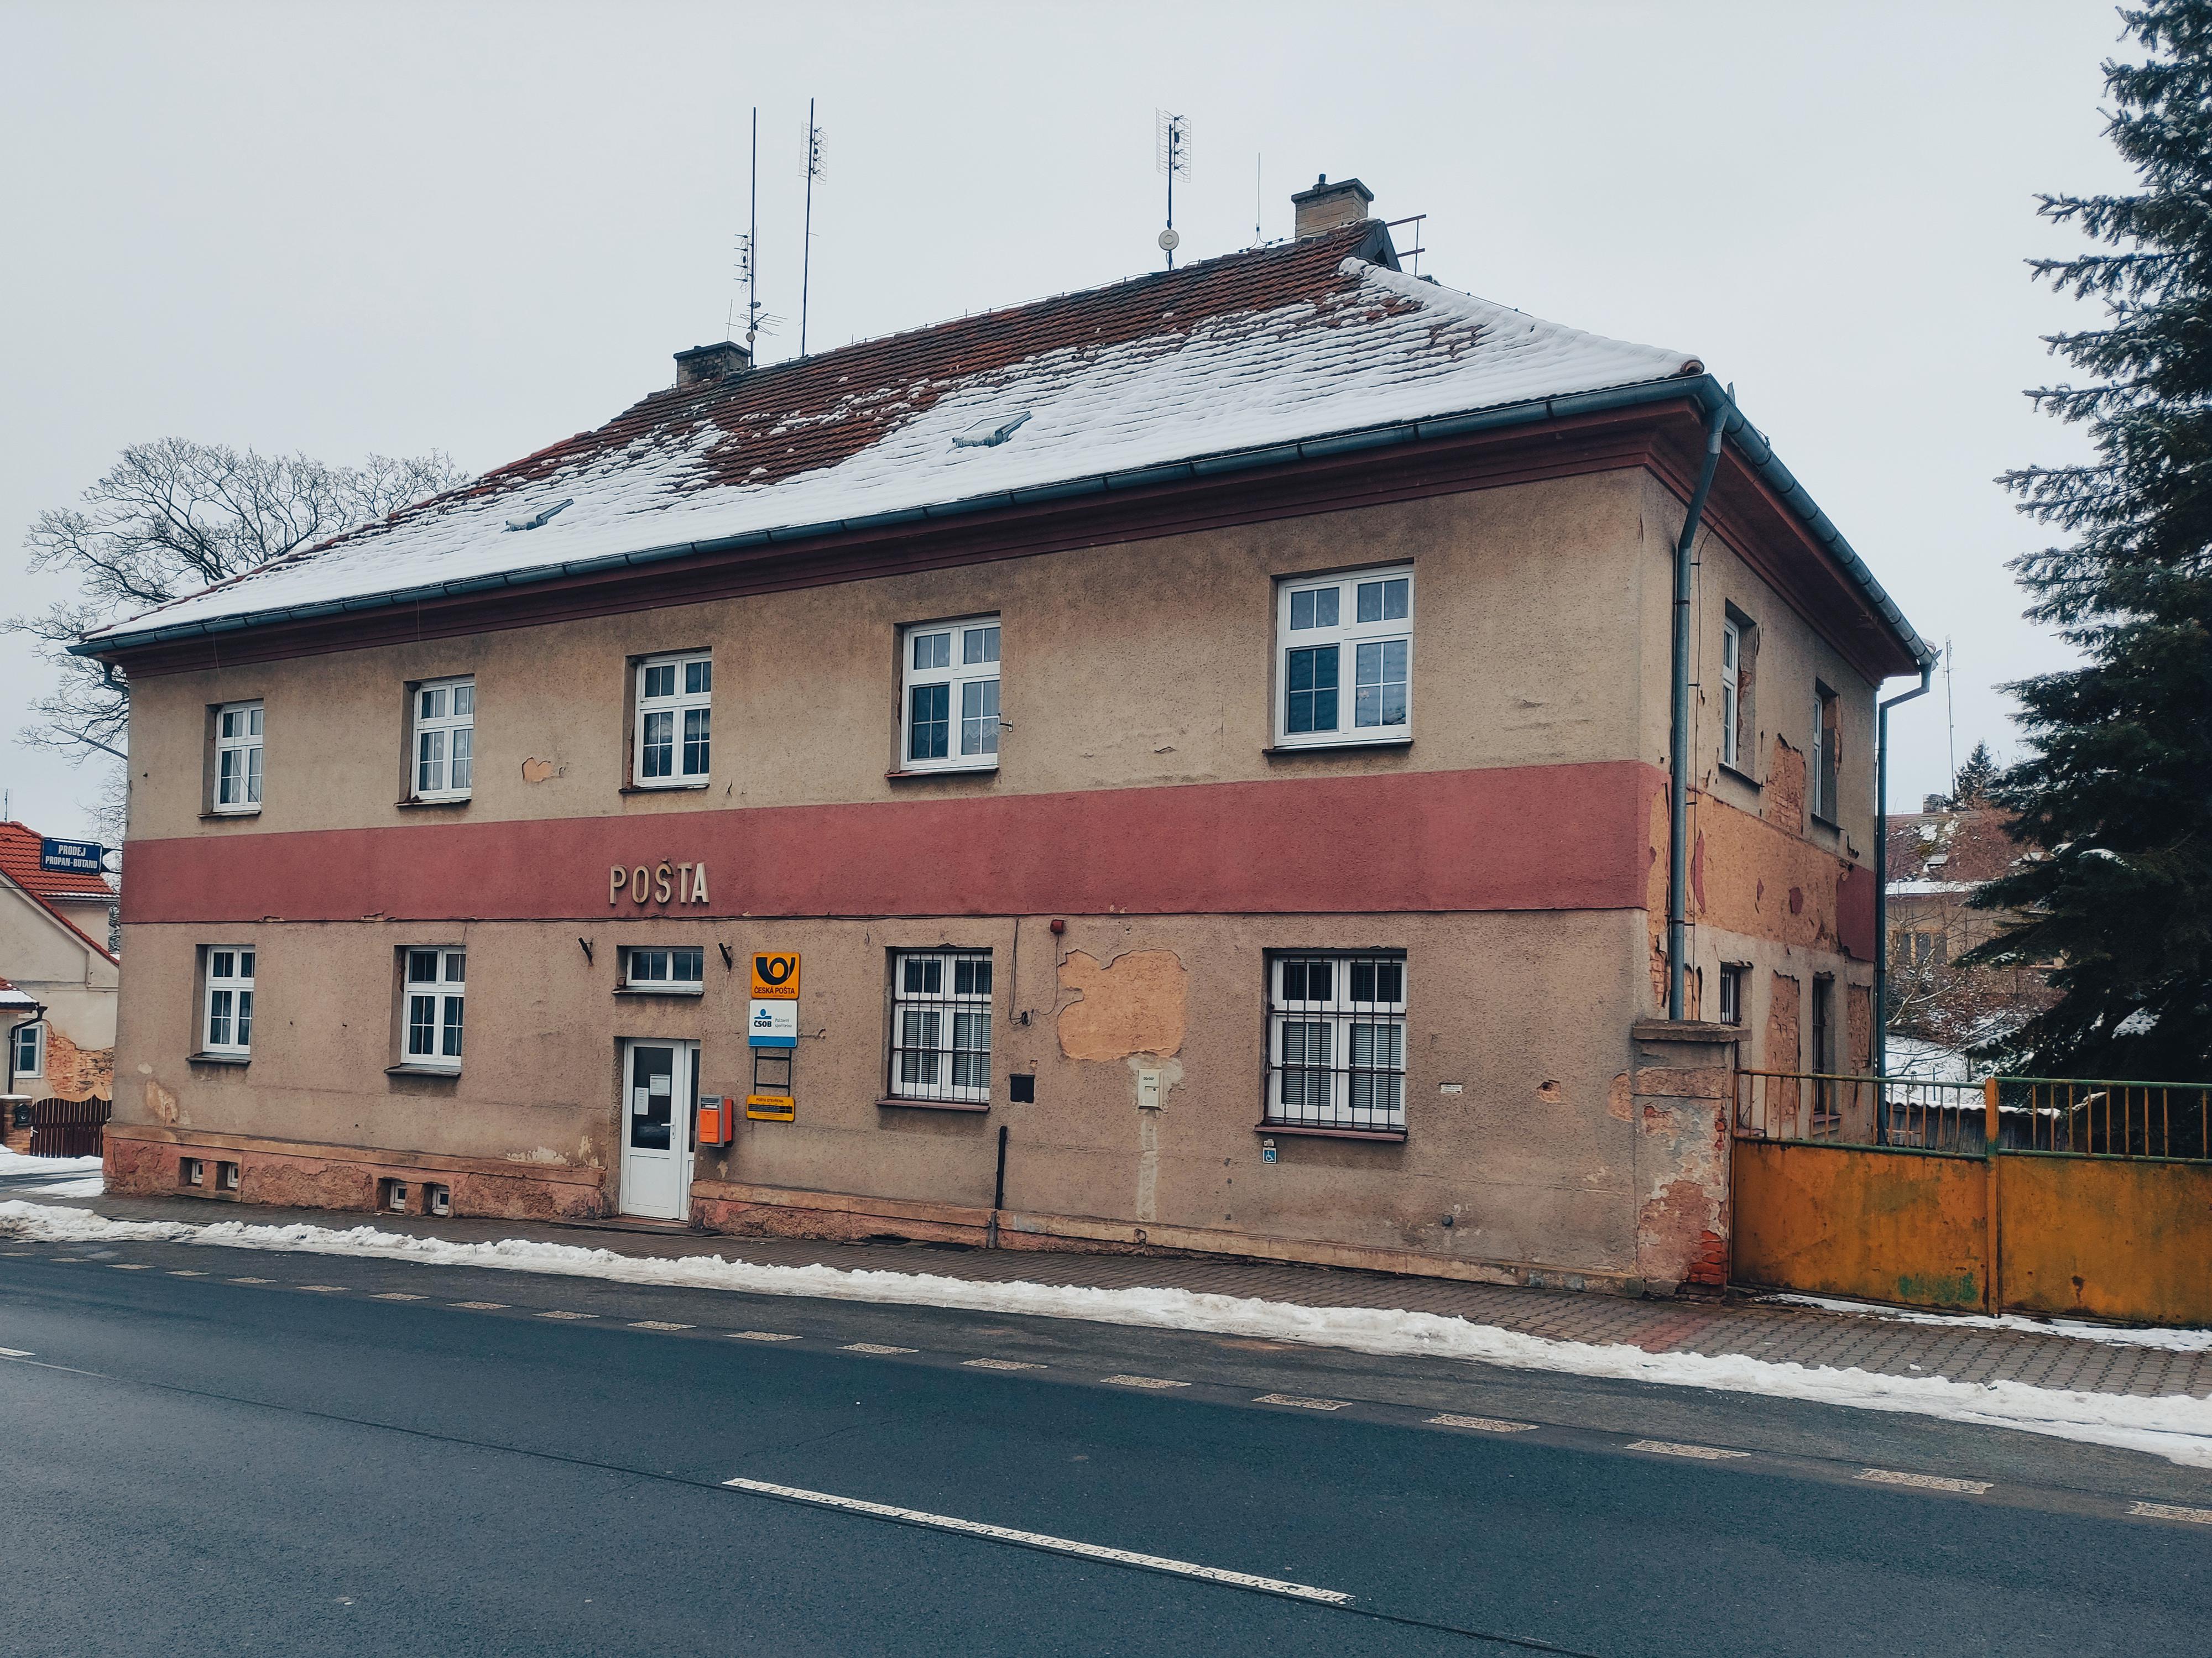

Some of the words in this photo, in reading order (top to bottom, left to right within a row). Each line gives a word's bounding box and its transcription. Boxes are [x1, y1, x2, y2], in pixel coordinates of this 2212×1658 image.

[58, 845, 86, 856] PRODEJ
[45, 855, 97, 869] PROPAN-BUTANU
[609, 856, 709, 904] POŠTA
[754, 986, 774, 994] ČESKÁ
[775, 986, 795, 995] POŠTA
